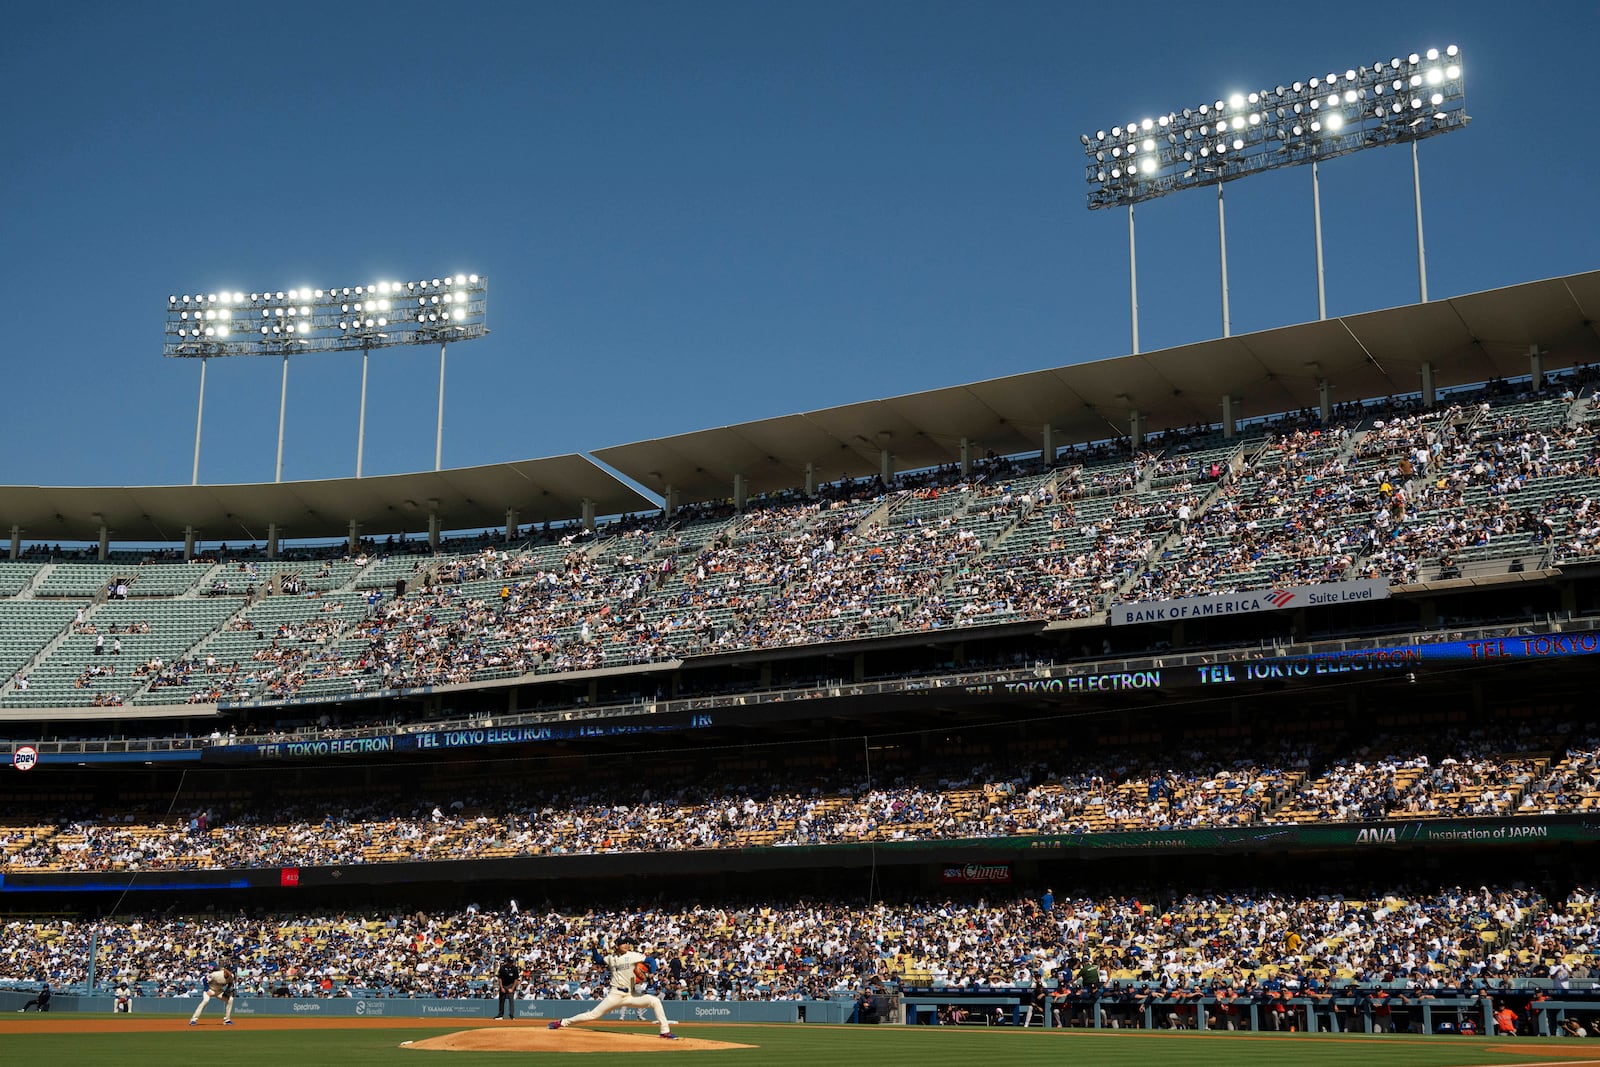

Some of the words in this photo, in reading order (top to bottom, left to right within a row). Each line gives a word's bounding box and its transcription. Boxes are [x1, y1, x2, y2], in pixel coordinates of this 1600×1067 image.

[1126, 609, 1165, 623] BANK
[1170, 606, 1188, 618] OF
[1192, 599, 1260, 616] AMERICA
[1309, 591, 1338, 604] Suite
[1341, 587, 1372, 601] Level
[1467, 641, 1512, 661] TEL
[1520, 634, 1597, 656] TOKYO
[1197, 665, 1236, 683] TEL
[1244, 658, 1310, 680] TOKYO
[1315, 649, 1422, 674] ELECTRON
[1068, 671, 1161, 692] ELECTRON
[258, 744, 282, 758] TEL
[287, 742, 328, 756] TOKYO
[330, 737, 394, 754] ELECTRON
[416, 733, 440, 748] TEL
[443, 731, 485, 746] TOKYO
[487, 728, 551, 744] ELECTRON
[16, 753, 36, 764] 2024
[1356, 827, 1398, 845] ANA
[1428, 828, 1491, 841] Inspiration
[1493, 826, 1506, 838] of
[1508, 826, 1548, 838] JAPAN
[293, 1003, 318, 1011] Spectrum
[695, 1006, 729, 1017] Spectrum
